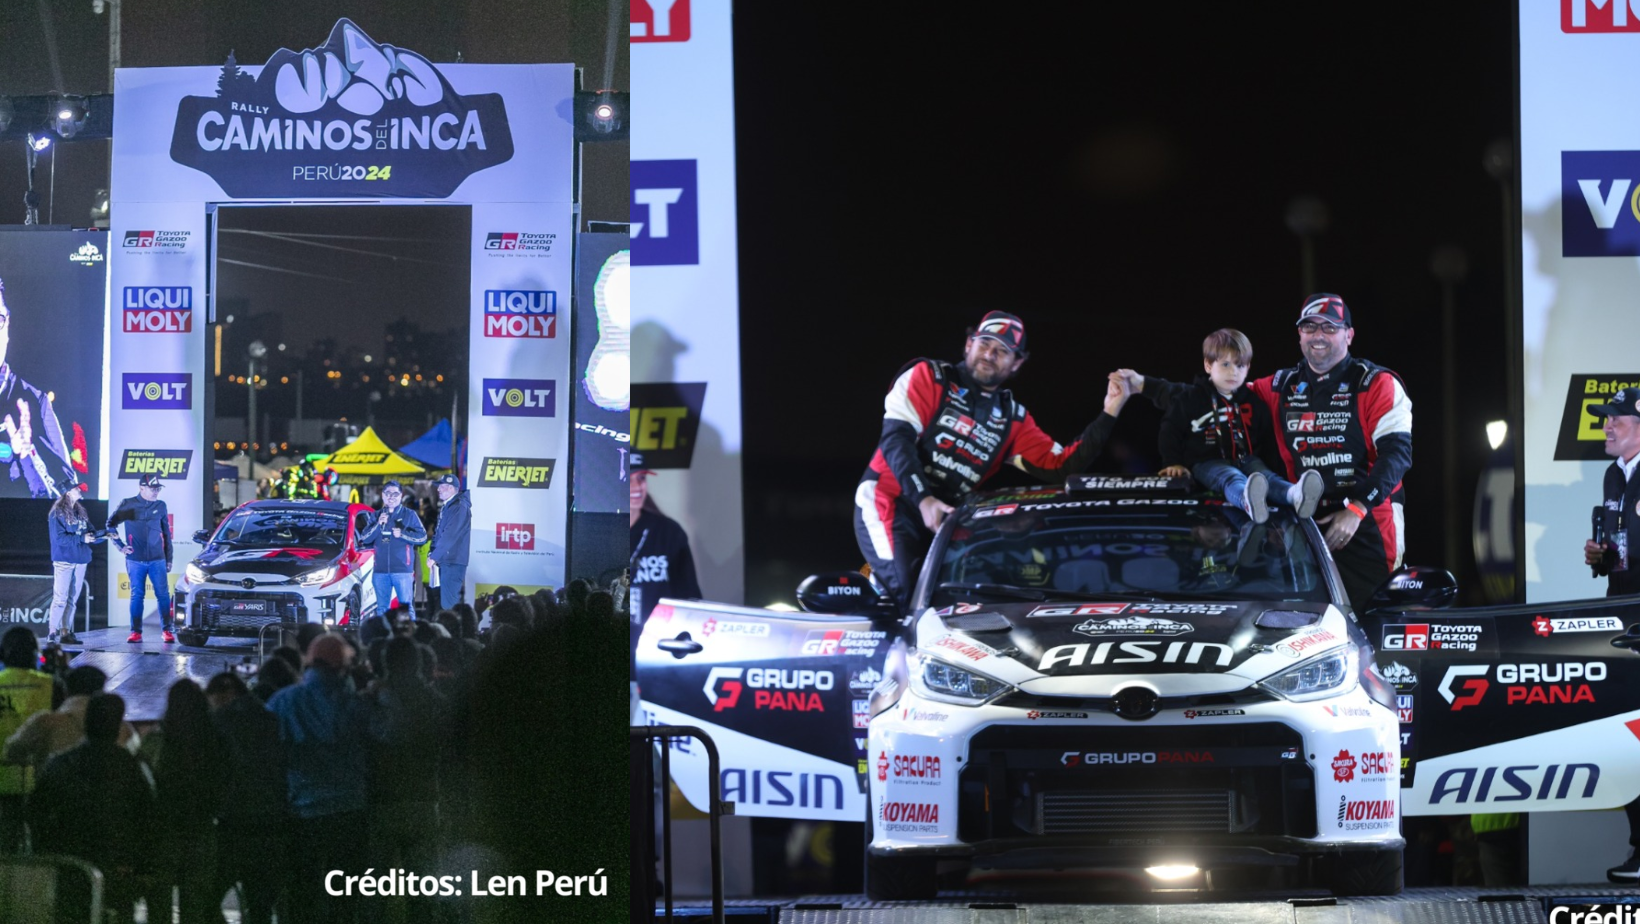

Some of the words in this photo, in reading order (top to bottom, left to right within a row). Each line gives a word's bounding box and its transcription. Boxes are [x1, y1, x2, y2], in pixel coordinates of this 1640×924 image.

[231, 101, 270, 115] RALLY
[196, 109, 373, 153] CAMINOS
[375, 118, 388, 150] DEL
[390, 109, 487, 151] INCA
[126, 288, 189, 310] LIQUI
[488, 292, 554, 314] LIQUI
[126, 311, 191, 331] MOLY
[487, 315, 555, 337] MOLY
[127, 382, 187, 400] VOLT
[488, 388, 551, 408] VOLT
[1315, 424, 1347, 432] Racing
[1307, 435, 1345, 444] GRUPO
[956, 439, 989, 461] GRUPO
[1301, 452, 1353, 467] Valvoline
[125, 458, 187, 477] ENERJET
[485, 465, 549, 487] ENERJET
[932, 451, 981, 483] Valvoline
[1085, 480, 1169, 489] SIEMPRE
[1021, 500, 1110, 511] TOYOTA
[501, 526, 531, 547] irtp
[1032, 606, 1122, 616] GR
[719, 624, 766, 635] ZAPLER
[1431, 624, 1482, 633] TOYOTA
[1557, 619, 1617, 630] ZAPLER
[840, 639, 879, 648] GAZOO
[845, 630, 887, 639] TOYOTA
[1383, 633, 1427, 649] GR
[1431, 633, 1478, 641] GAZOO
[801, 639, 838, 655] GR
[838, 647, 874, 658] Racing
[1037, 641, 1235, 670] AISIN
[1431, 641, 1476, 651] Racing
[747, 668, 834, 691] GRUPO
[1496, 662, 1608, 683] GRUPO
[755, 691, 825, 712] PANA
[1507, 684, 1596, 705] PANA
[893, 755, 941, 778] SAKURA
[721, 768, 844, 810] AISIN
[1428, 763, 1600, 805] AISIN
[883, 802, 939, 823] KOYAMA
[1345, 800, 1395, 820] KOYAMA
[919, 825, 939, 833] PARTS
[1346, 822, 1382, 831] SUSPENSION
